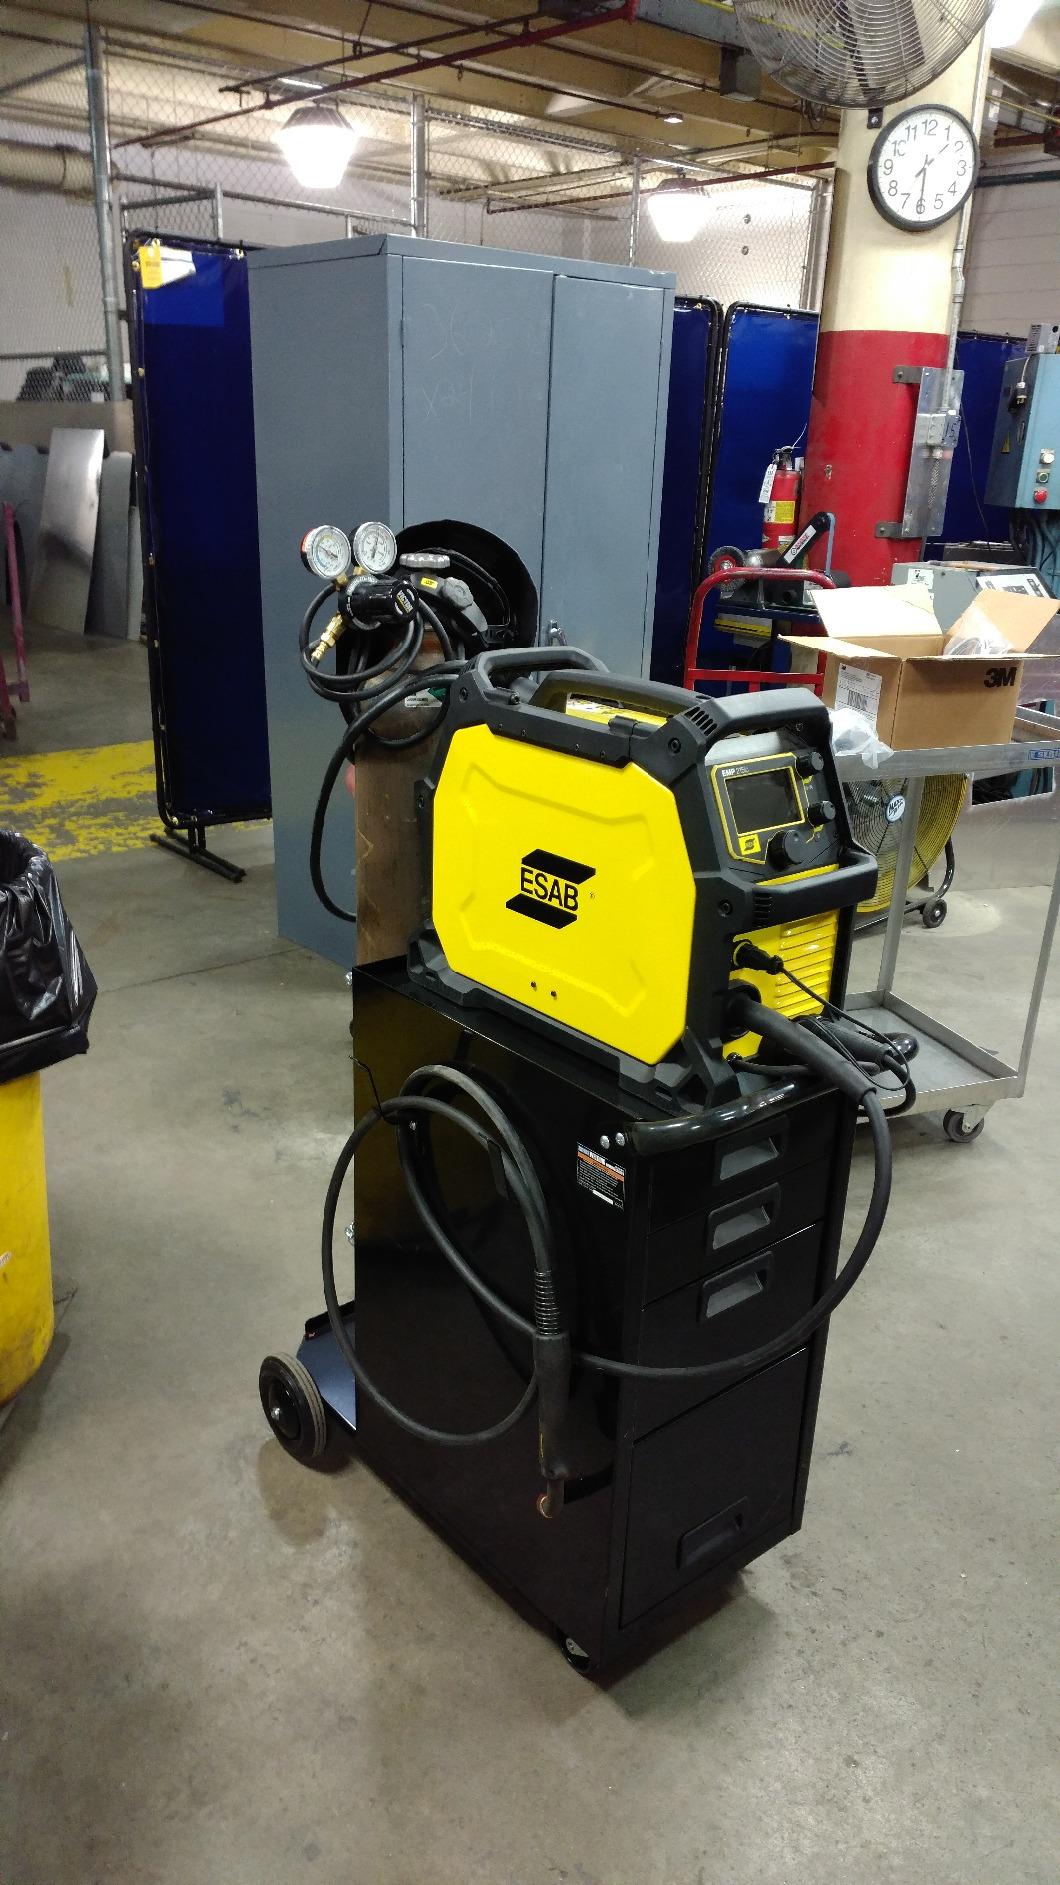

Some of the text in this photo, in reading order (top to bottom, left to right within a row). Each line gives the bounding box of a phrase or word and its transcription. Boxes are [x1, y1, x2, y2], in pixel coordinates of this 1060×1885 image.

[905, 124, 918, 141] 11
[922, 119, 938, 136] 12
[945, 125, 951, 141] 1
[891, 140, 906, 156] 10
[954, 140, 964, 155] 2
[883, 159, 893, 175] 9
[957, 160, 966, 176] 3
[888, 180, 898, 196] 8
[948, 181, 957, 196] 4
[901, 193, 911, 209] 7
[916, 199, 925, 214] 6
[934, 194, 943, 209] 5
[983, 667, 1018, 688] 3M
[721, 767, 736, 778] EMP
[520, 866, 579, 912] ESAB
